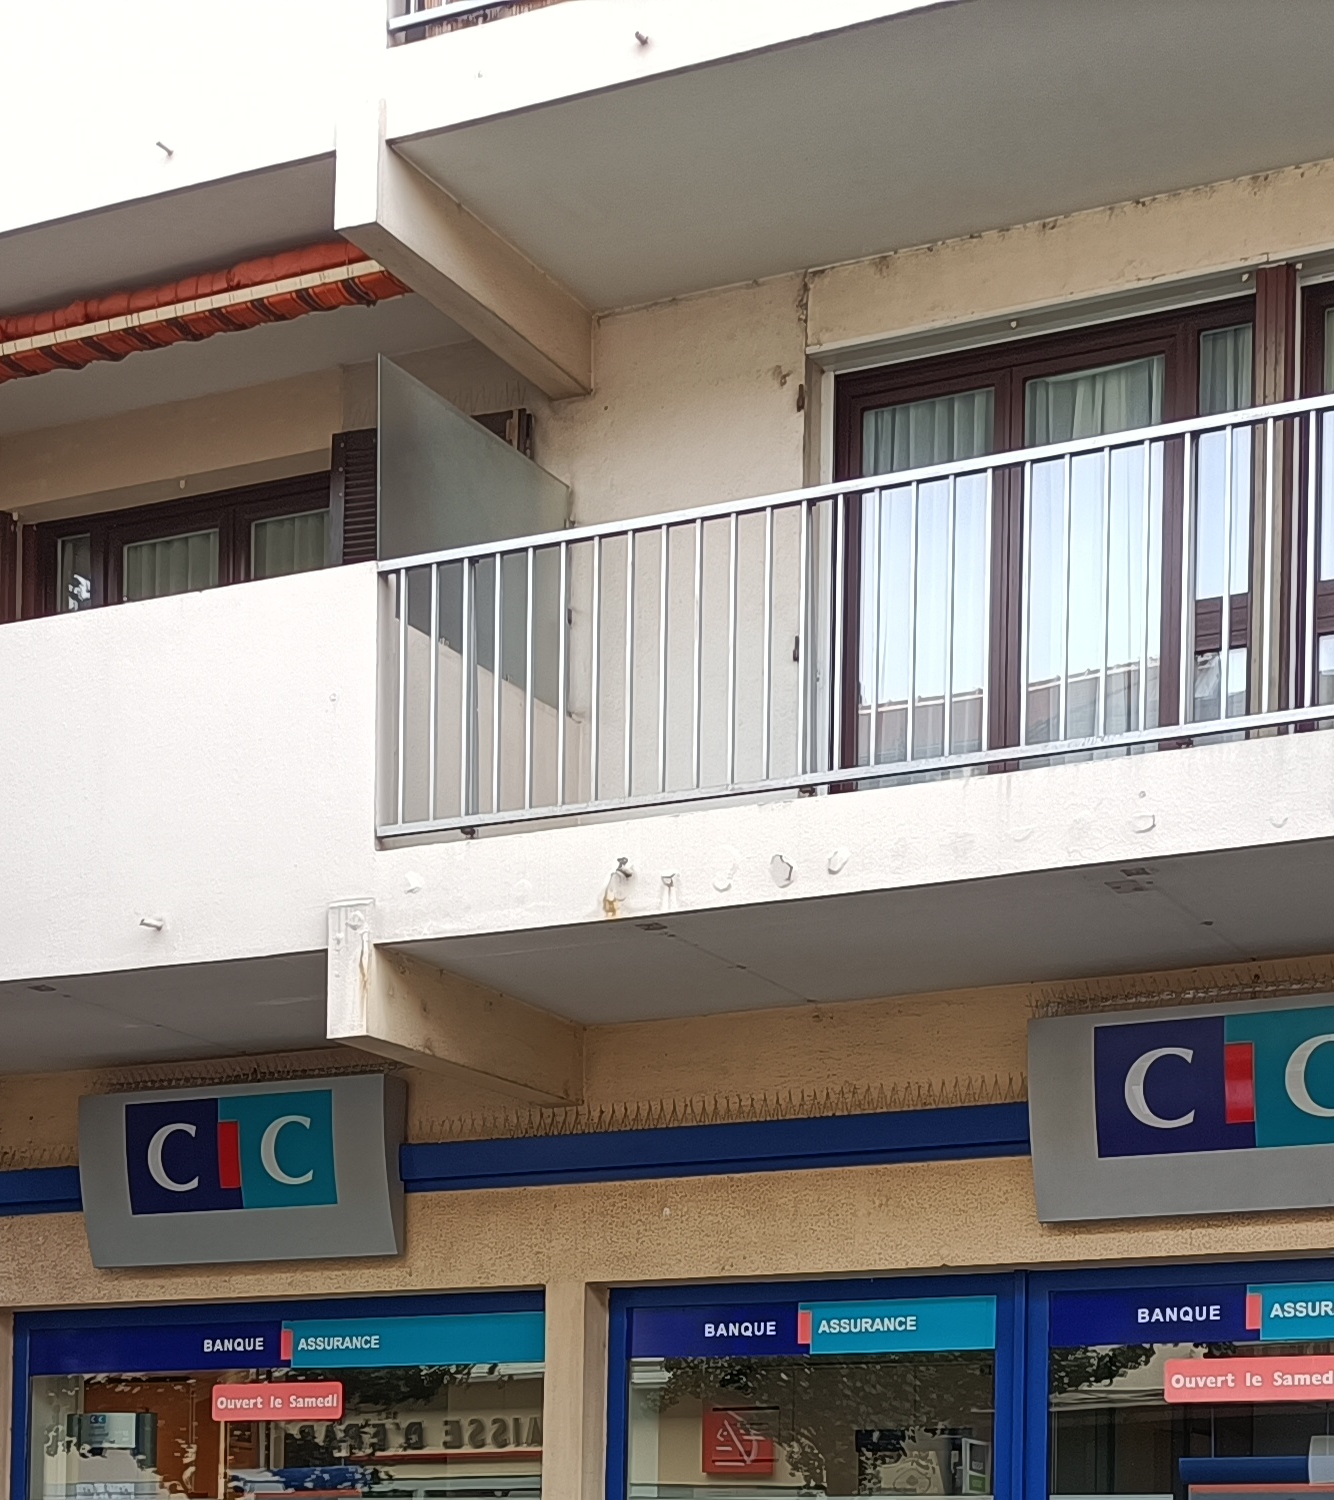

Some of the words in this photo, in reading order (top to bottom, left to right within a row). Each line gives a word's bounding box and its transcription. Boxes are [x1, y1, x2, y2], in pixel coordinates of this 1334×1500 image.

[147, 1114, 315, 1193] CIC
[1137, 1305, 1221, 1323] BANQUE
[704, 1321, 777, 1337] BANQUE
[818, 1316, 917, 1334] ASSURANCE
[203, 1337, 264, 1352] BANQUE
[297, 1335, 380, 1351] ASSURANCE
[1171, 1371, 1235, 1389] Ouvert
[1245, 1371, 1262, 1387] le
[217, 1395, 263, 1409] Ouvert
[270, 1395, 283, 1408] le
[289, 1394, 337, 1409] Samedi
